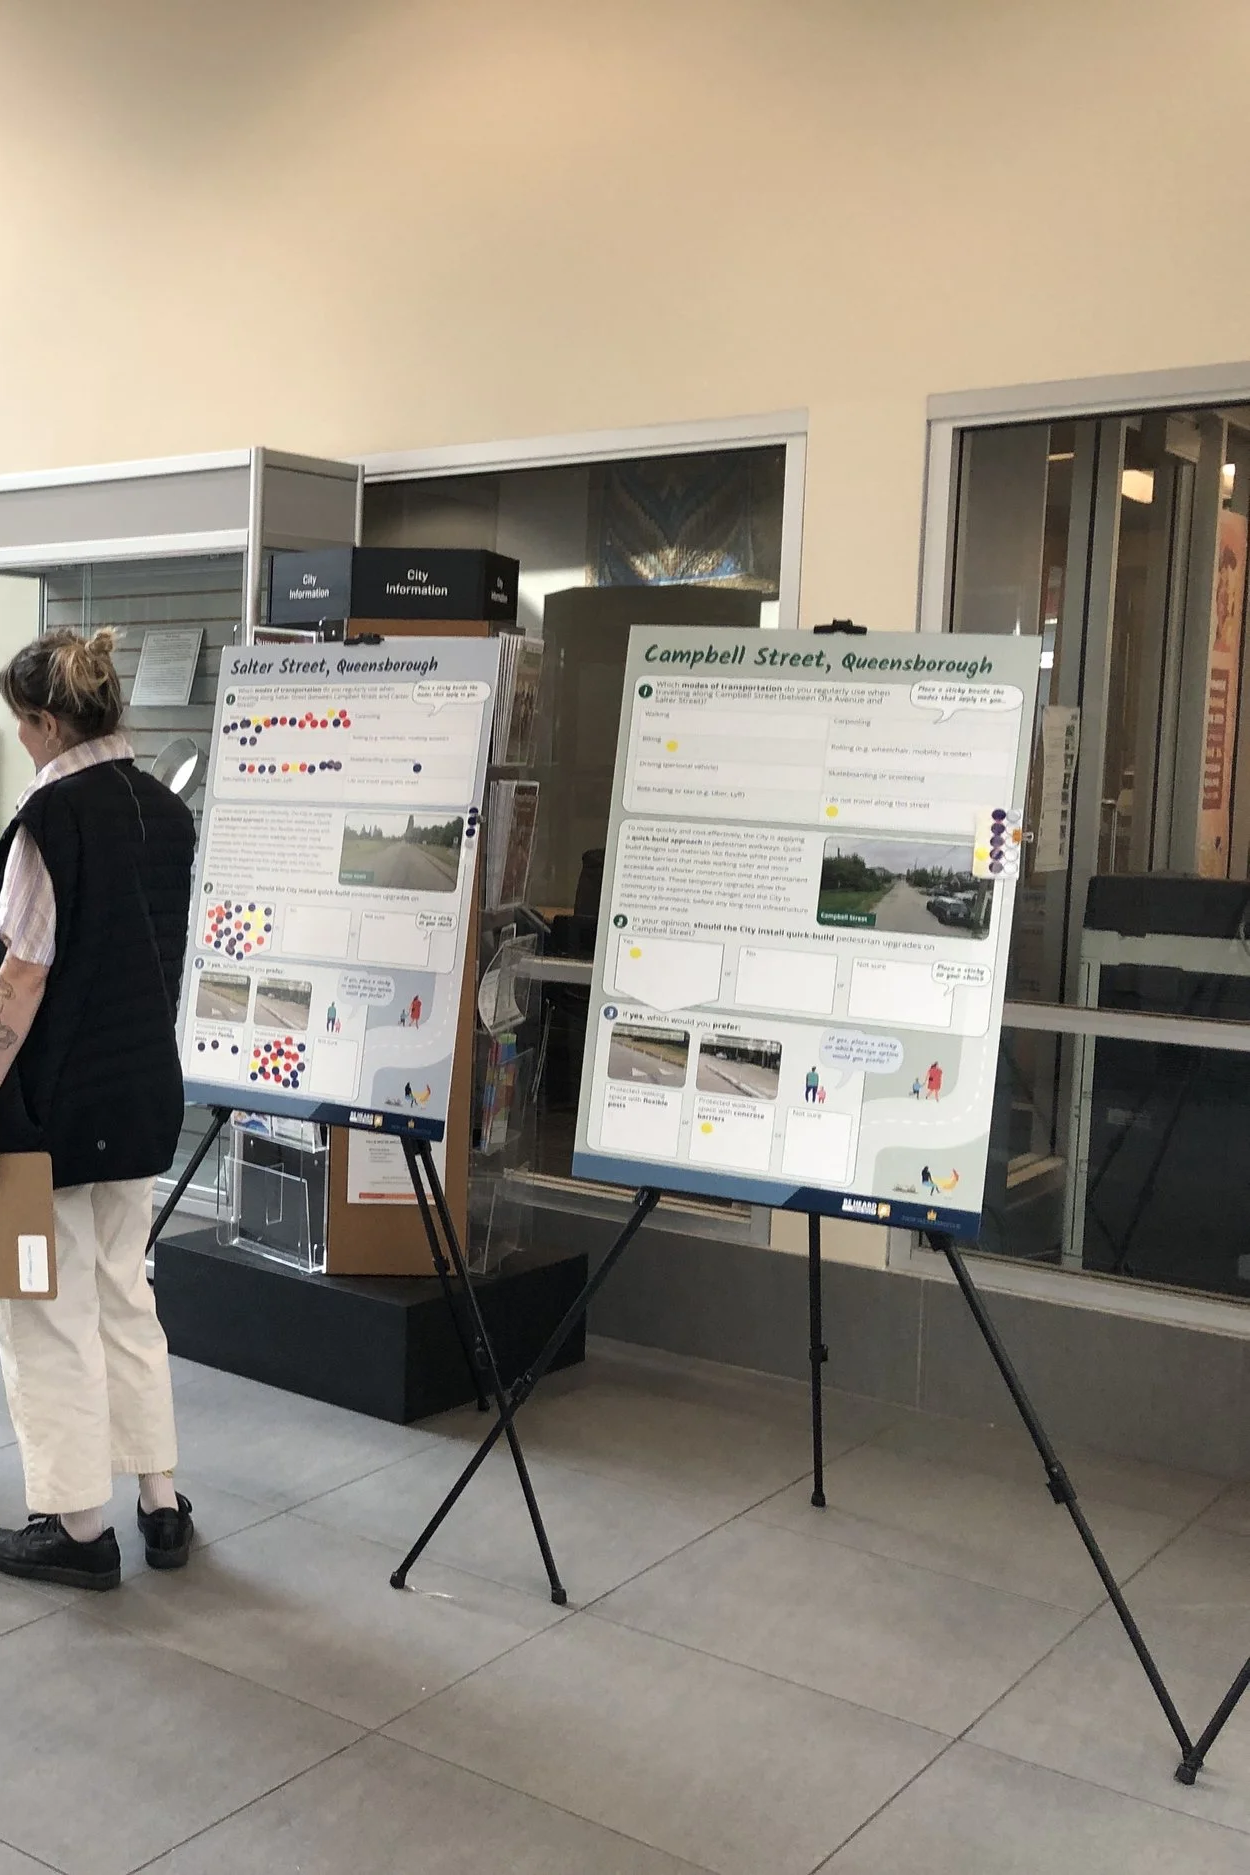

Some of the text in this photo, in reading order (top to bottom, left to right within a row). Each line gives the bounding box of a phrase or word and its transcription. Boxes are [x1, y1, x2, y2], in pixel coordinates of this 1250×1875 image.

[303, 574, 317, 586] City
[408, 569, 429, 583] City
[290, 587, 329, 600] Information
[386, 583, 447, 596] Information
[231, 656, 438, 678] Salter Street, Queensborough
[645, 644, 992, 679] Campbell Street, Queensborough
[721, 683, 782, 692] transportation
[828, 770, 877, 781] Skateboarding
[758, 926, 784, 936] install
[787, 931, 834, 942] quick-build
[836, 935, 880, 946] pedestrian
